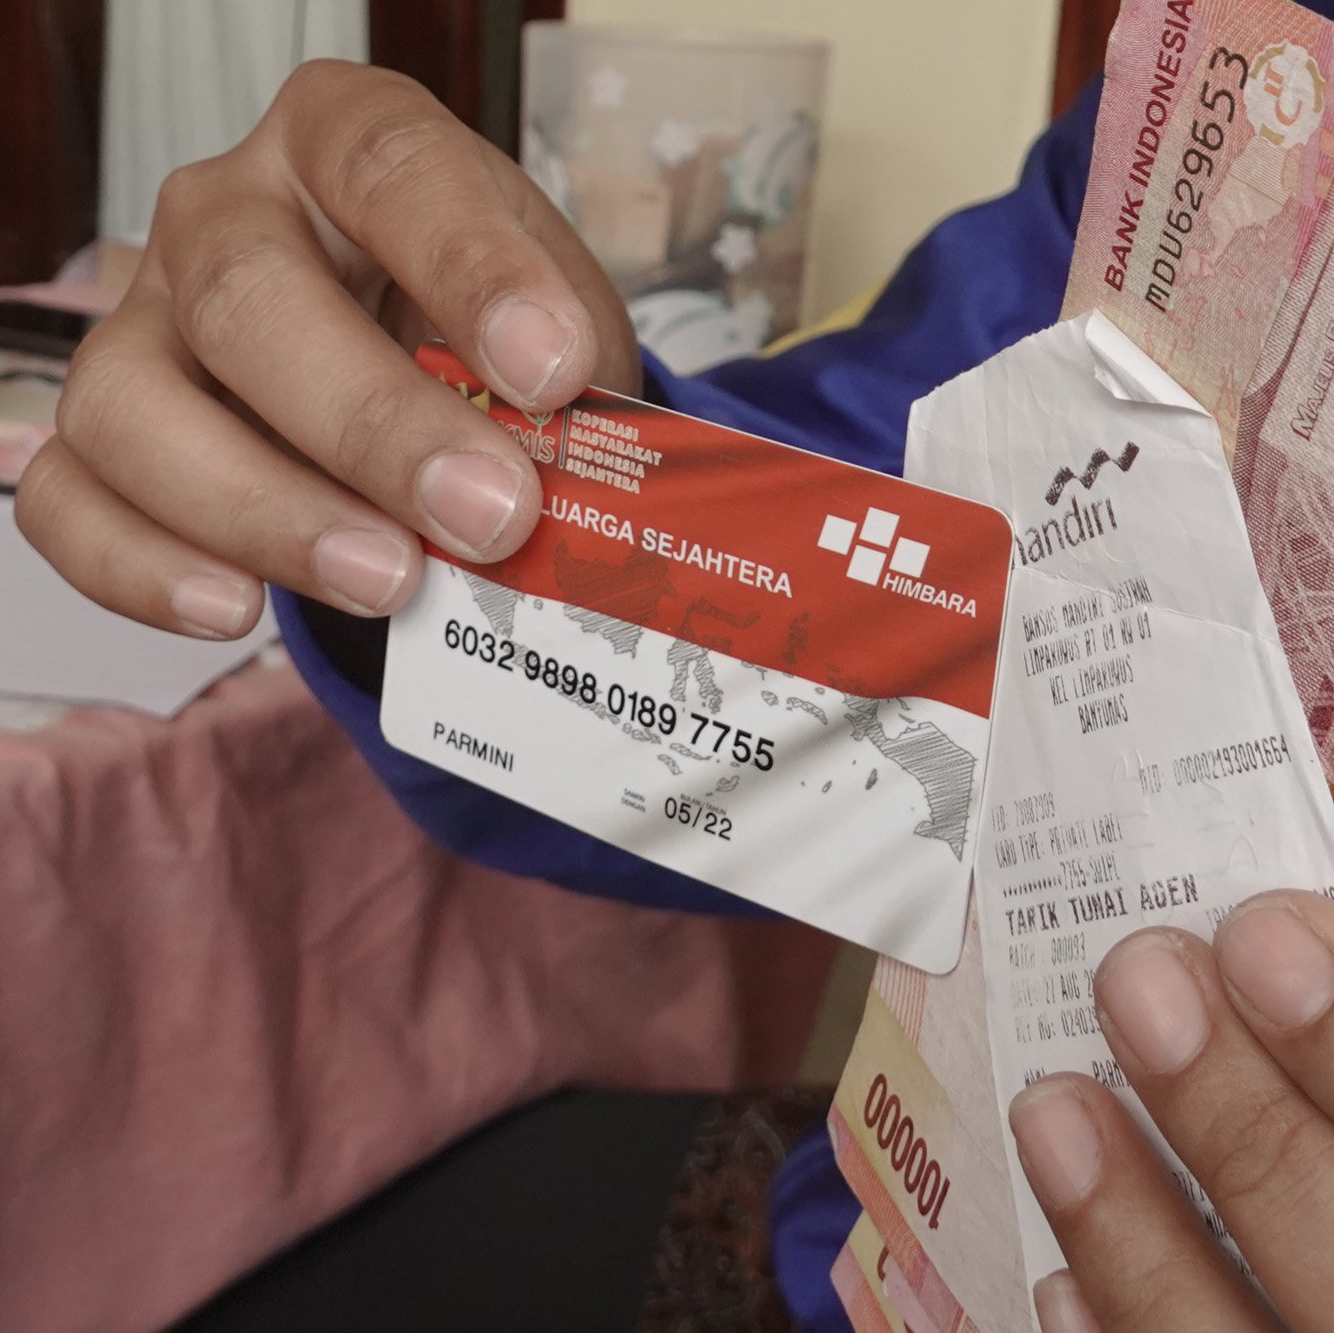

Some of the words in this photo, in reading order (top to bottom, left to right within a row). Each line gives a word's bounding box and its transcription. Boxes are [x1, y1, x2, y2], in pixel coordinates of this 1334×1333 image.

[1104, 190, 1144, 291] BANK
[1129, 0, 1194, 187] INDONESIA
[1145, 47, 1248, 312] MDU629653
[569, 425, 662, 466] MASYARAKAT
[571, 409, 639, 442] KOPERASI
[567, 441, 645, 479] INDONESIA
[640, 526, 793, 598] SEJAHTERA
[882, 572, 978, 618] HIMBARA
[1138, 611, 1152, 640] 01
[444, 619, 515, 671] 6032
[524, 650, 598, 704] 9898
[607, 683, 678, 735] 0189
[689, 713, 775, 772] 7755
[433, 722, 514, 772] PARMINI
[665, 797, 732, 841] 05/22
[1006, 902, 1060, 936] TARIK
[1069, 886, 1128, 924] TUNAI
[1140, 873, 1199, 910] AGEN
[1060, 973, 1081, 1000] AUG
[864, 1073, 950, 1230] 100000
